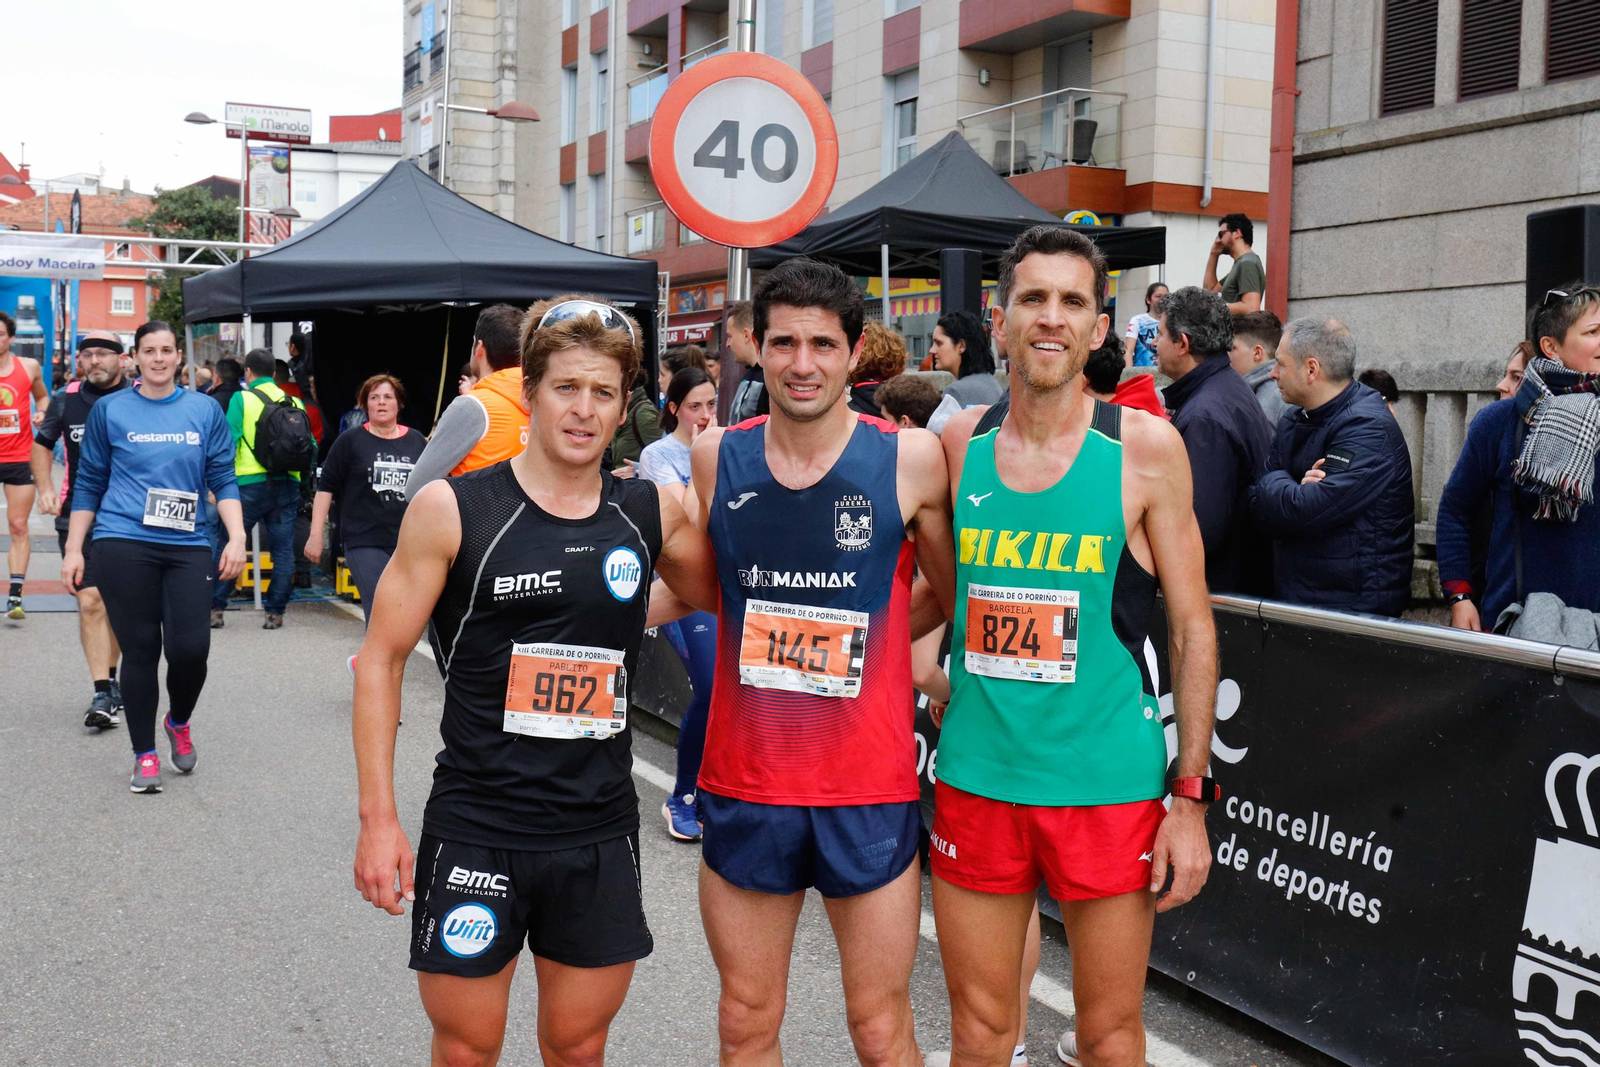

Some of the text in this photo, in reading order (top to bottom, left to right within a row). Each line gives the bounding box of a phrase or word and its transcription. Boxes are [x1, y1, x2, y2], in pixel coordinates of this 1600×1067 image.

[228, 106, 290, 117] RESTAURANTE
[260, 118, 310, 132] Manolo
[693, 119, 799, 184] 40
[38, 258, 96, 270] Maceira
[126, 431, 184, 444] Gestamp
[380, 470, 407, 486] 1565
[155, 500, 187, 520] 1520
[836, 542, 871, 552] ATLETISMO
[959, 527, 1106, 573] BIKILA
[493, 570, 562, 595] BMC
[738, 566, 857, 588] RUNMANIAK
[494, 588, 554, 601] SWITZERLAND
[978, 590, 1004, 599] CARREIRA
[751, 603, 762, 612] XIII
[765, 606, 796, 615] CARREIRA
[989, 604, 1033, 614] BARGIELA
[983, 614, 1040, 657] 824
[531, 647, 564, 656] CARREIRA
[768, 630, 830, 672] 1145
[549, 662, 588, 673] PABLITO
[532, 672, 597, 715] 962
[1225, 796, 1393, 873] concellería
[448, 866, 509, 891] BMC
[1216, 833, 1382, 924] de deportes
[446, 884, 500, 898] SWITZERLAND
[424, 918, 436, 948] CRAFT
